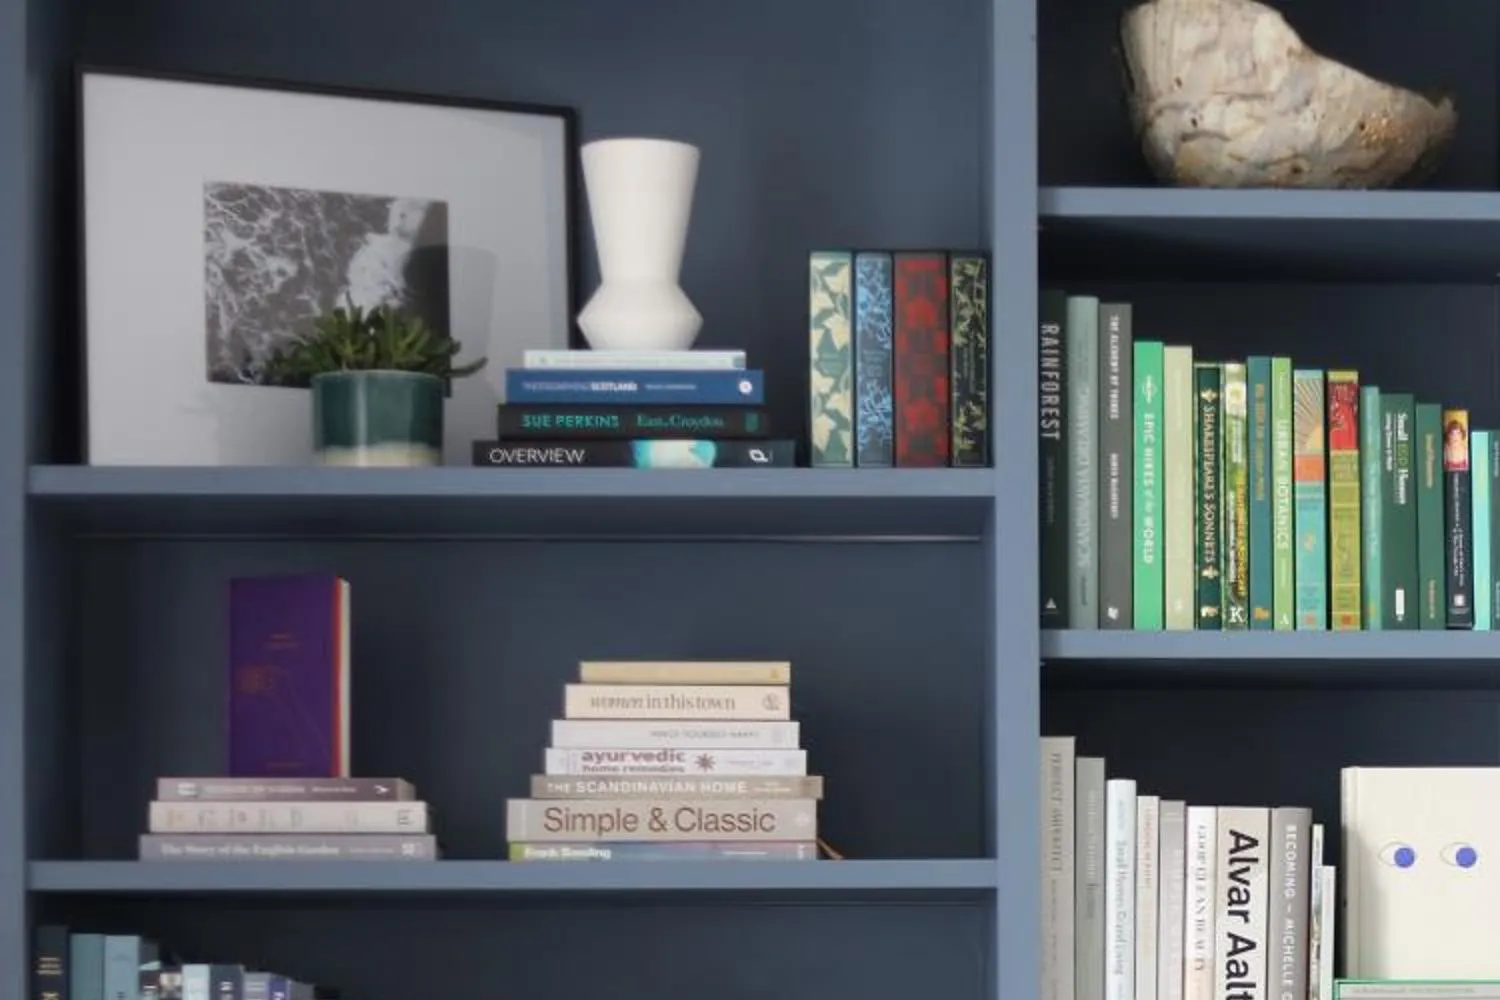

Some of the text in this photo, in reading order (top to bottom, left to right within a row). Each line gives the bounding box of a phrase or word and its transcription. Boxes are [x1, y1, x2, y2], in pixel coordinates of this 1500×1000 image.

[1041, 323, 1060, 441] RAINFOREST
[522, 415, 619, 428] SUE PERKINS
[1143, 412, 1155, 444] EPIC
[489, 448, 585, 464] OVERVIEW
[1143, 516, 1155, 564] WORLD
[581, 750, 686, 764] ayurvedic
[547, 780, 748, 794] THE SCANDINAVIAN HOME
[543, 807, 776, 837] Simple & Classic
[1227, 829, 1259, 924] Alvar
[1285, 824, 1297, 898] BECOMING
[1283, 919, 1295, 985] MICHELLE
